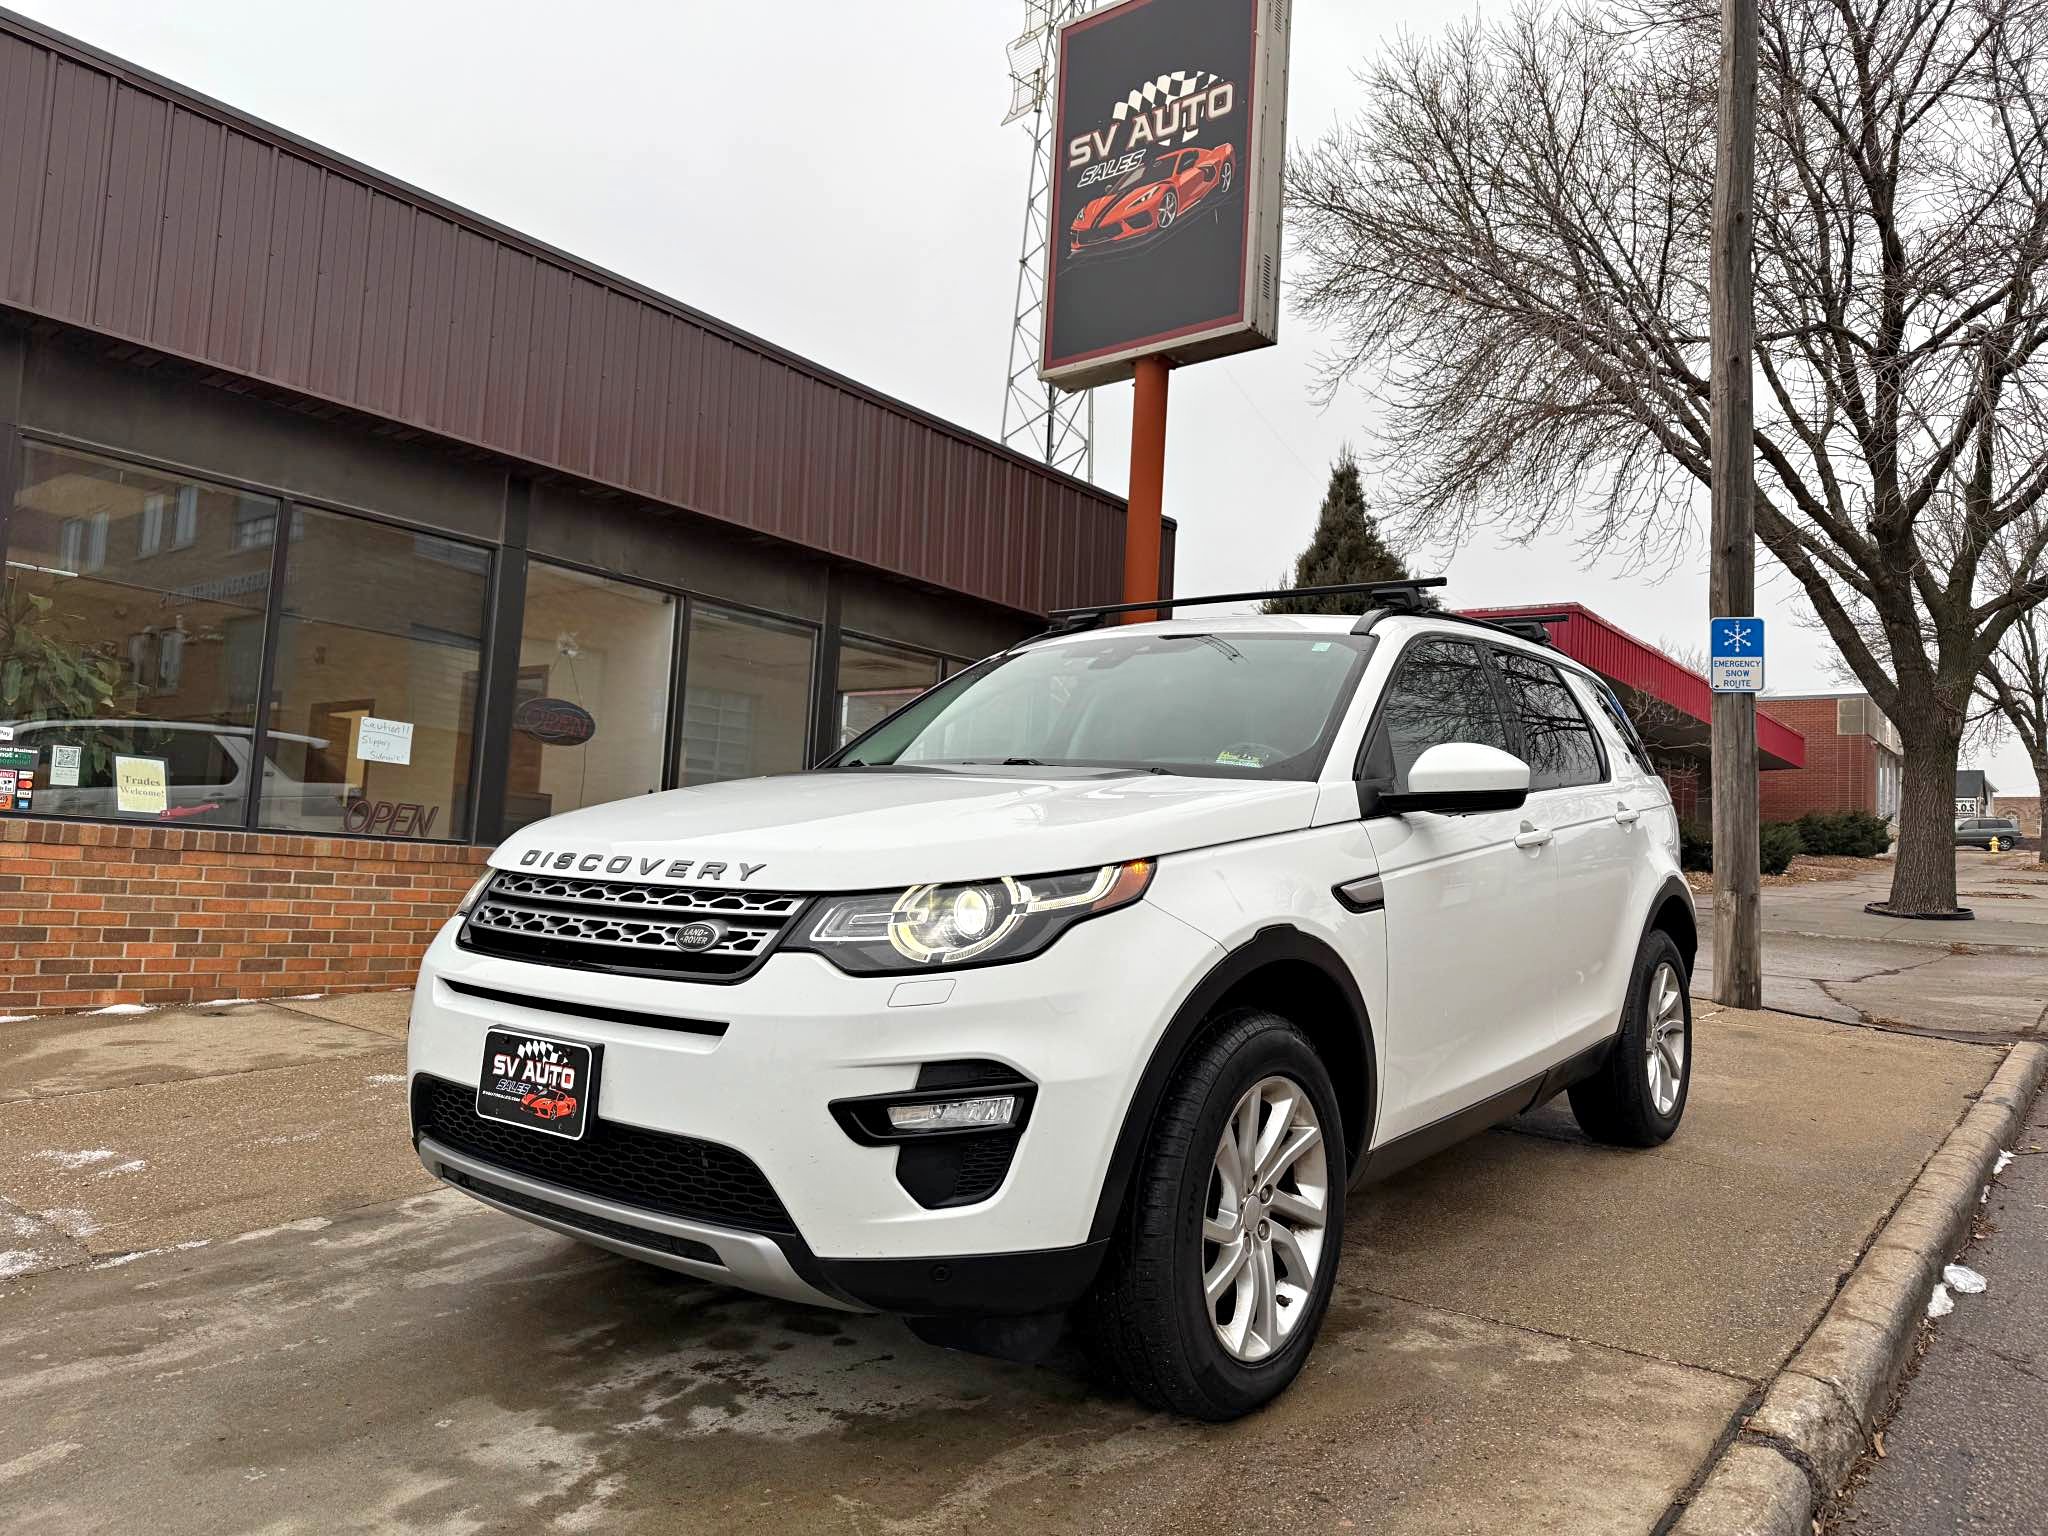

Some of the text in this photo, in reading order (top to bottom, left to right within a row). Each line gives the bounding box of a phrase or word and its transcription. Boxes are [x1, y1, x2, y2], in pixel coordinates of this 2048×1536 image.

[1069, 82, 1234, 169] SV AUTO
[1077, 148, 1147, 188] SALES
[1713, 660, 1761, 668] EMERGENCY
[1725, 669, 1750, 677] SNOW
[1723, 679, 1752, 688] ROUTE
[123, 775, 161, 787] Trades
[120, 785, 165, 798] Welcome!
[344, 800, 440, 837] OPEN
[520, 849, 768, 881] DISCOVERY
[492, 1053, 576, 1090] SV AUTO
[495, 1078, 531, 1096] SALES
